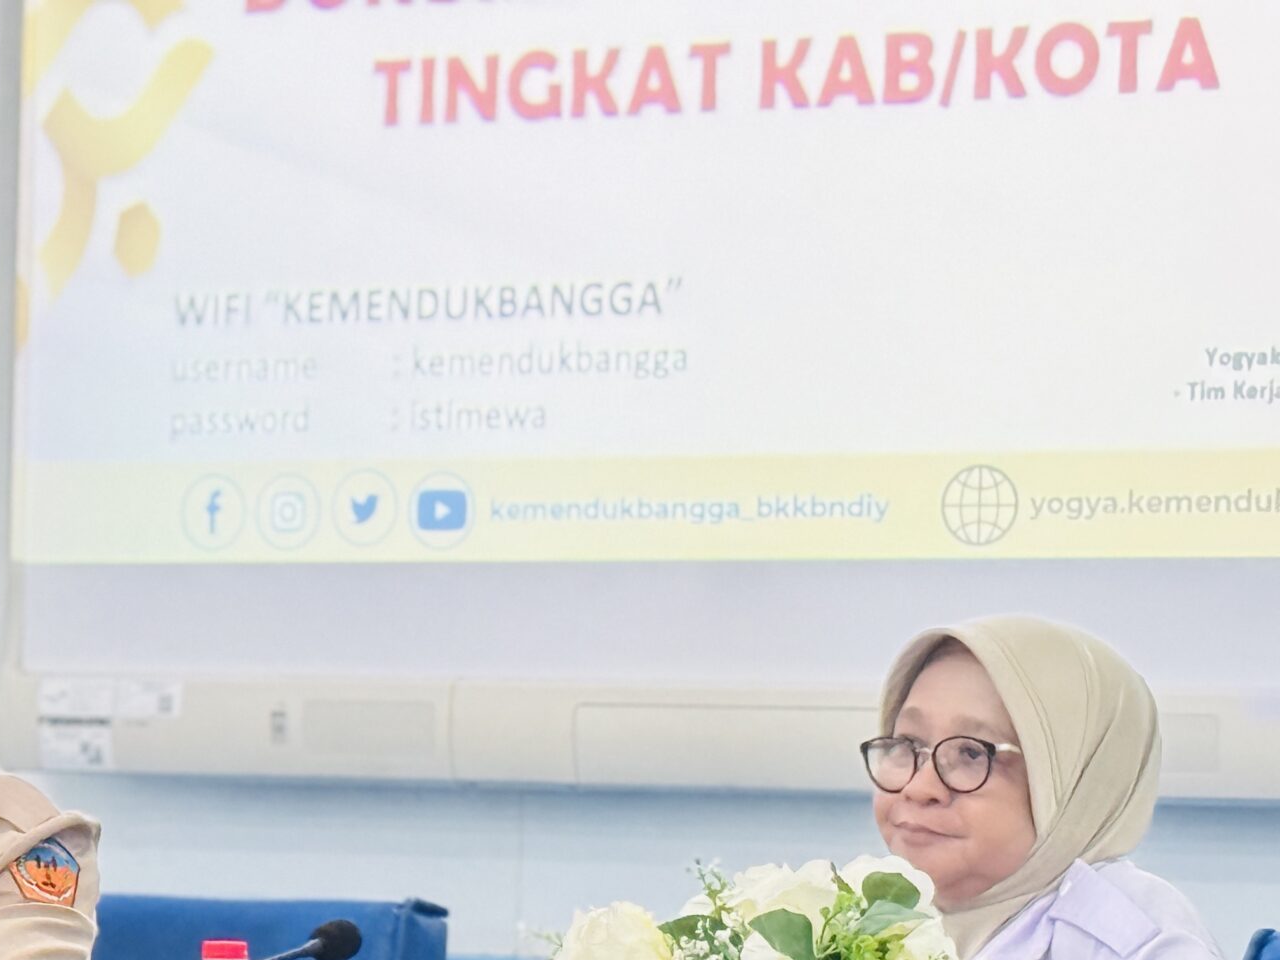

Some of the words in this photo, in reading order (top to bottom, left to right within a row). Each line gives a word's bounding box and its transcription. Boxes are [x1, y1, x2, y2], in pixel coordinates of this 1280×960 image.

[373, 41, 732, 127] TINGKAT
[757, 16, 1221, 110] KAB/KOTA
[173, 291, 252, 327] WIFI
[170, 351, 319, 384] username
[412, 341, 689, 381] kemendukbangga
[1186, 379, 1226, 402] Tim
[169, 401, 311, 442] password
[410, 399, 548, 433] istimewa
[489, 492, 891, 527] kemendukbangga_bkkbndiy
